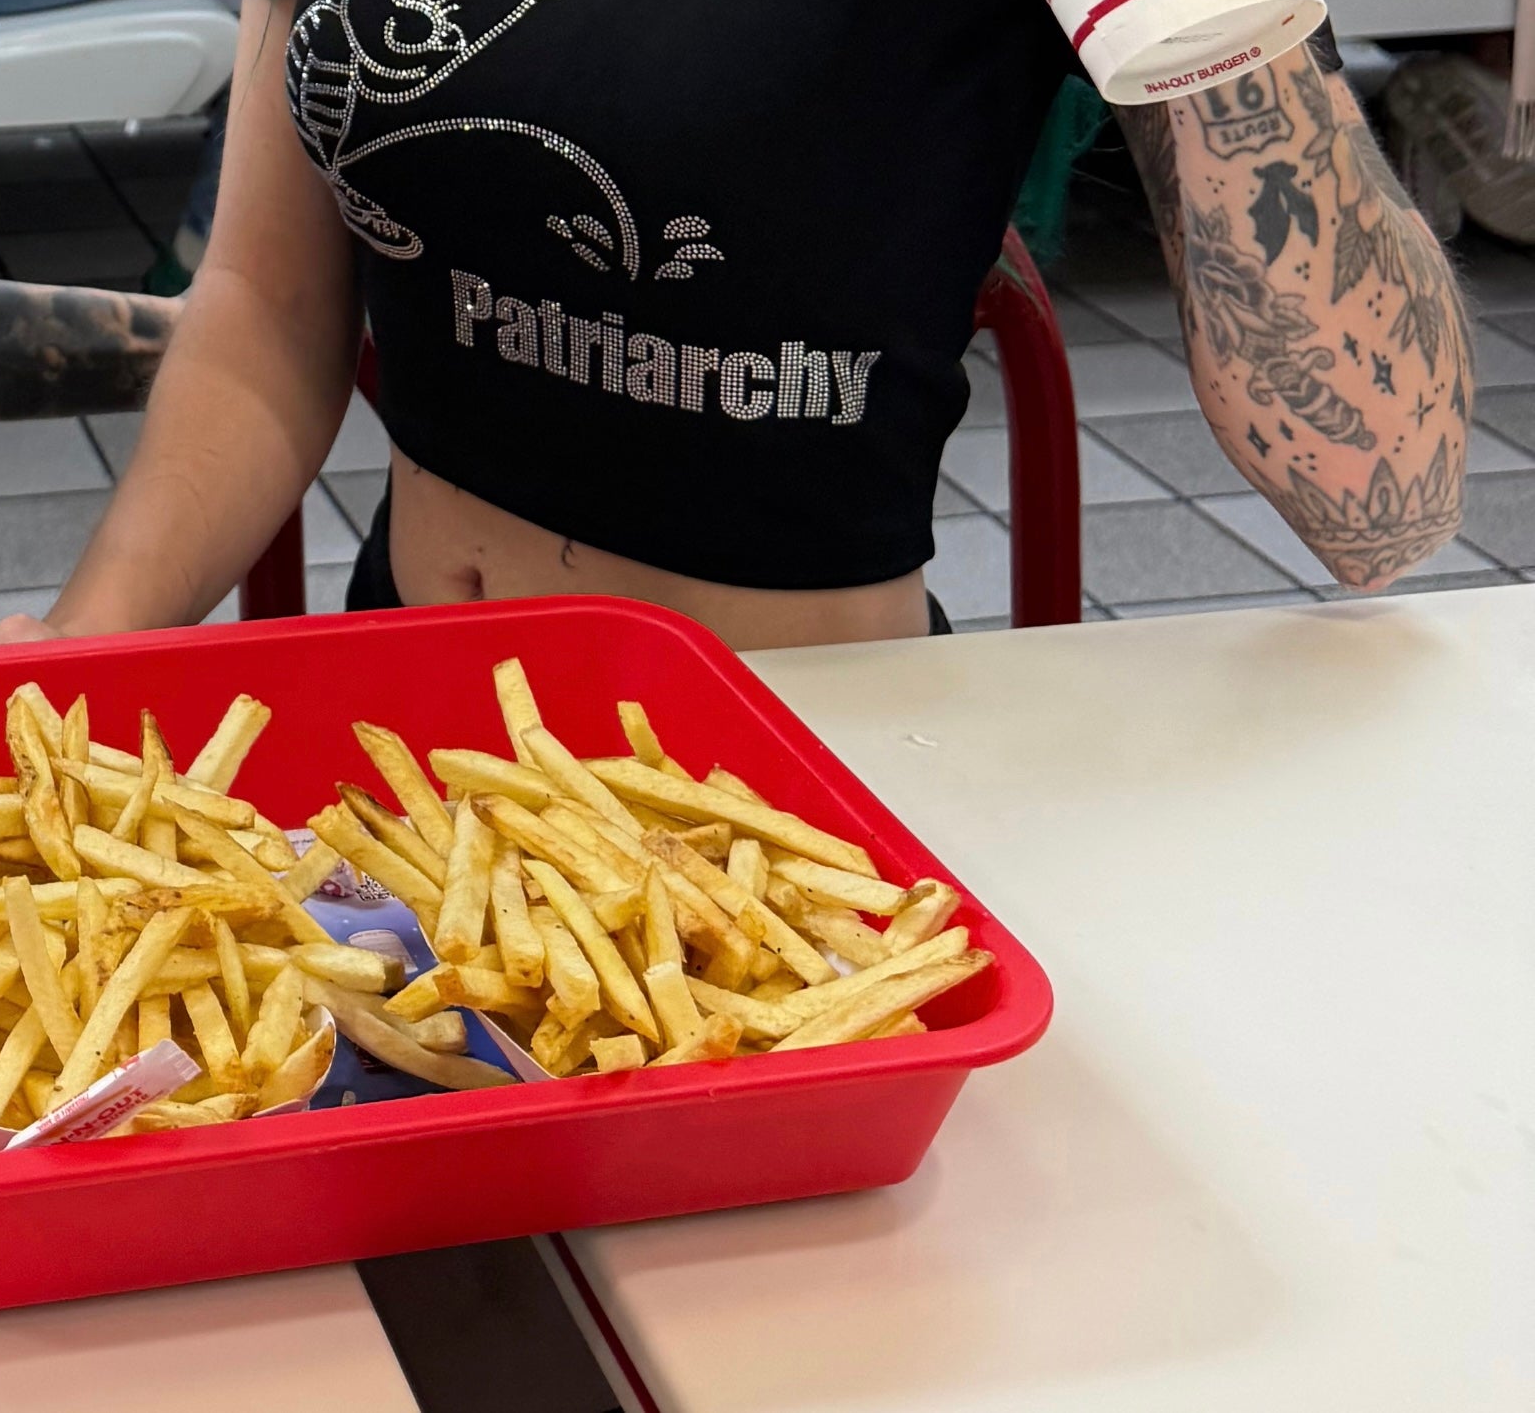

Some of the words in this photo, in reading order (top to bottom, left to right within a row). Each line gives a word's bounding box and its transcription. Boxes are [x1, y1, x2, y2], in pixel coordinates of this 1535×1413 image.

[1144, 72, 1196, 94] IN-N-OUT
[1197, 51, 1251, 81] BURGER
[1219, 116, 1281, 146] ROUTE
[451, 269, 881, 426] Patriarchy
